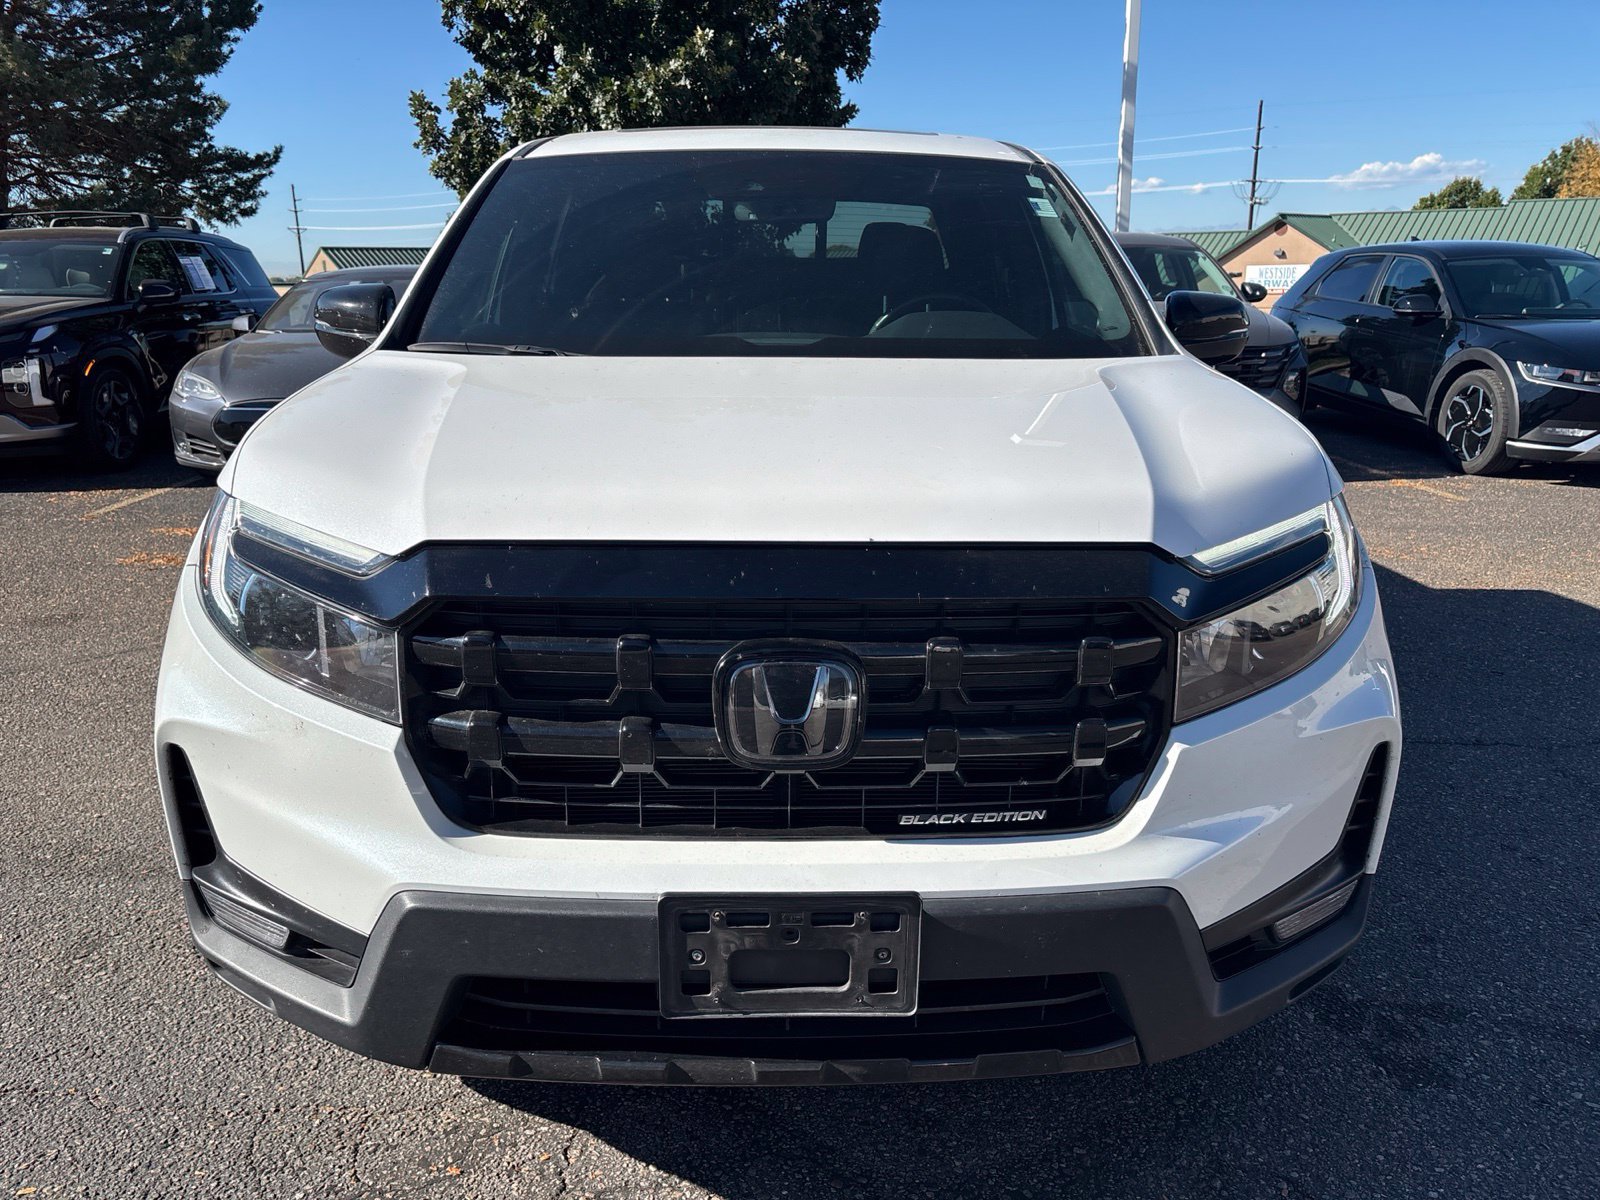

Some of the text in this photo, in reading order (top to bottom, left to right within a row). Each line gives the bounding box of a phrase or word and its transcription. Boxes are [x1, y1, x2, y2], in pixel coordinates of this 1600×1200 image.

[1259, 267, 1297, 279] WESTSIDE
[899, 809, 1047, 825] BLACK EDITION
